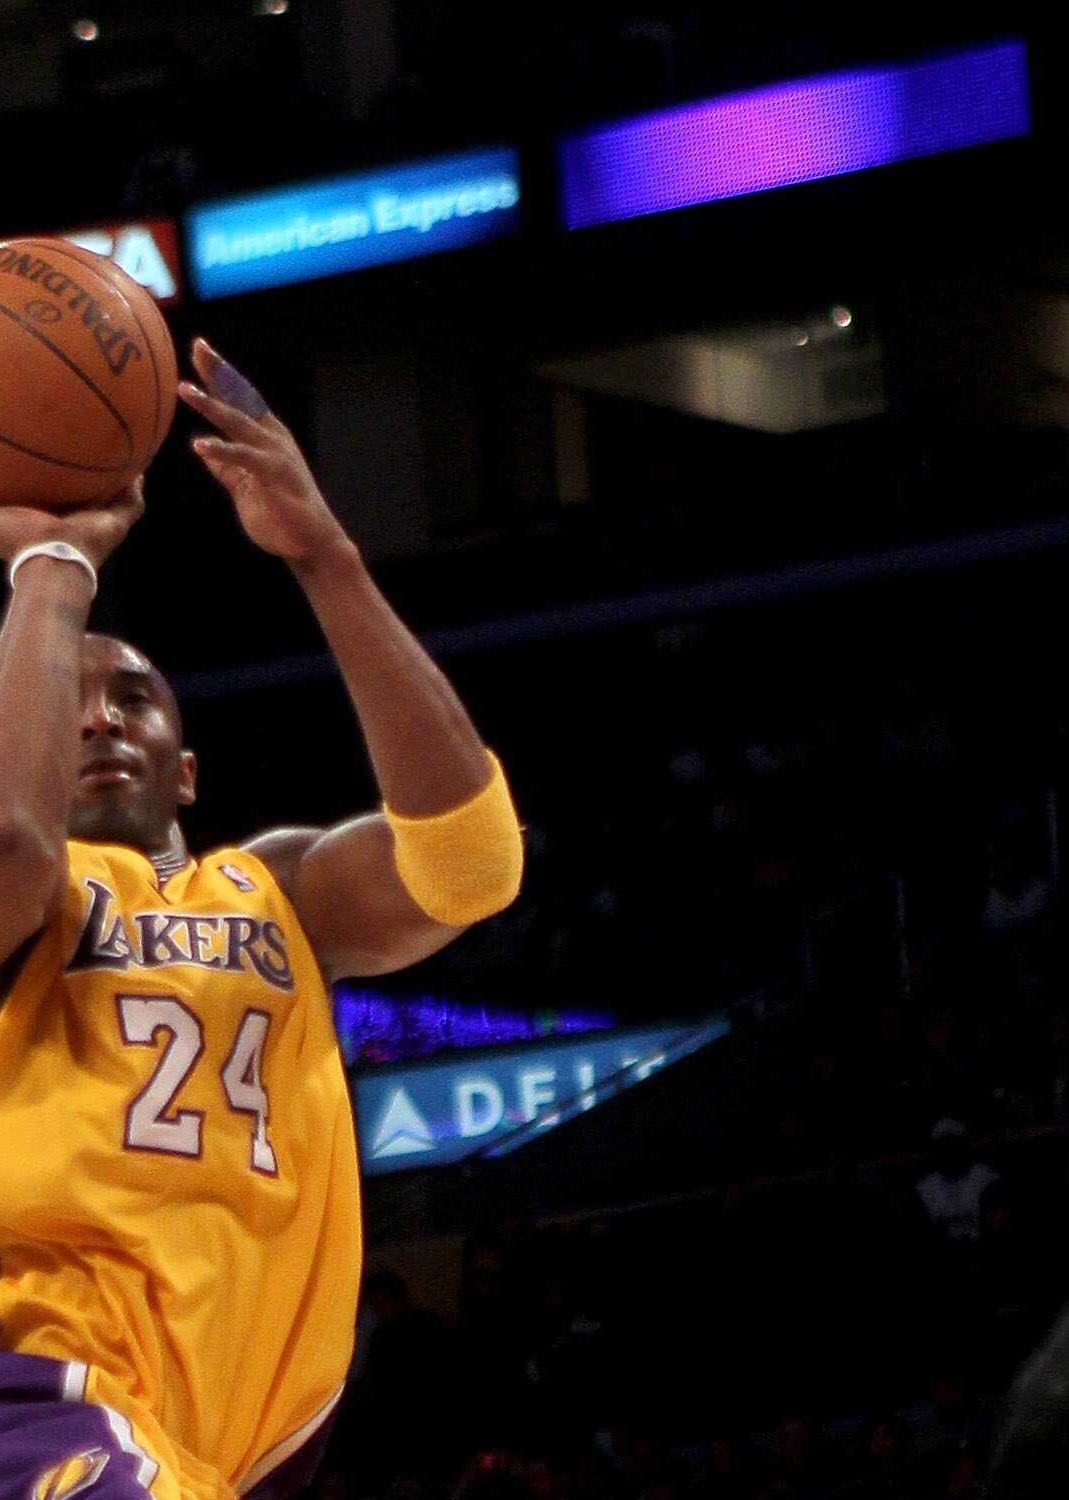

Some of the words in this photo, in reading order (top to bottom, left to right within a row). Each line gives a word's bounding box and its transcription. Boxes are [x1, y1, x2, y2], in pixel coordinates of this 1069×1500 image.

[199, 209, 371, 269] American
[374, 178, 520, 234] Express
[64, 877, 295, 993] LAKERS
[115, 993, 278, 1177] 24
